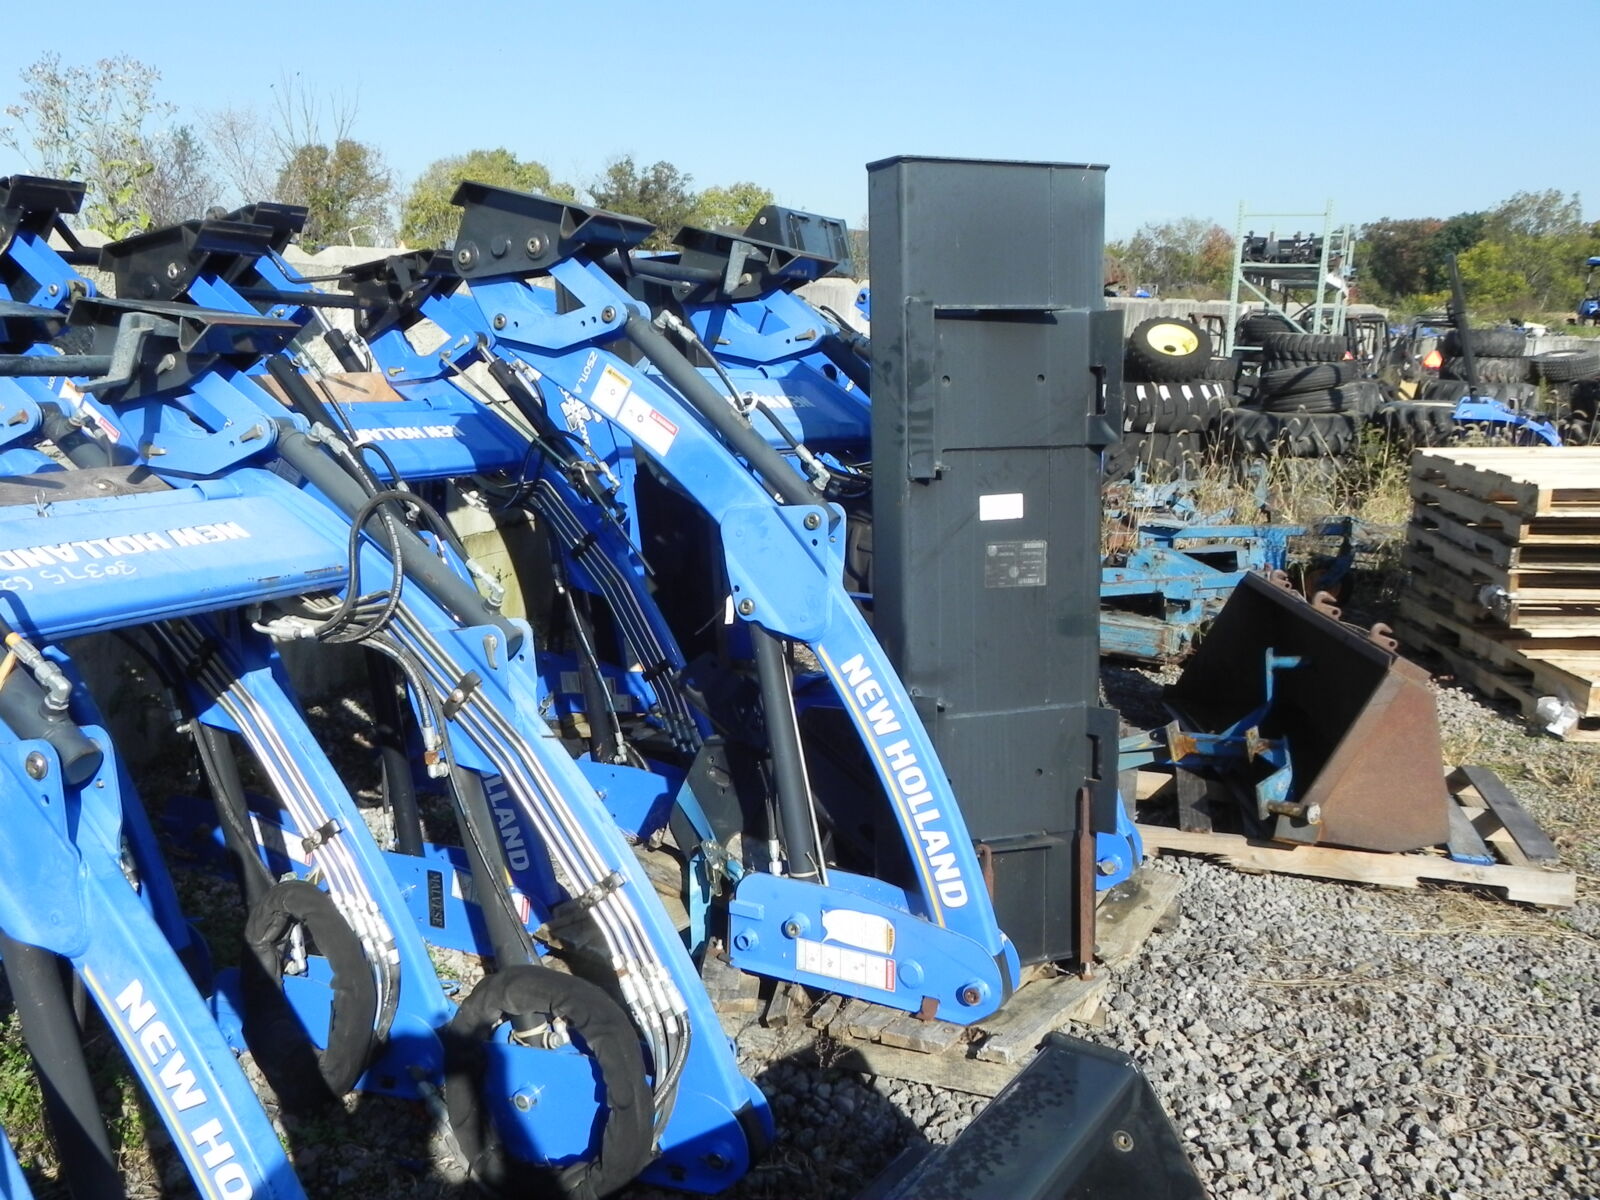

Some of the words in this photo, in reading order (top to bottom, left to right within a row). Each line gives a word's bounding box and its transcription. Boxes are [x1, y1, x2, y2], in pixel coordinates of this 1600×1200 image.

[344, 426, 427, 441] HOLLAN
[0, 532, 172, 571] HOLLAND
[165, 521, 250, 547] NEW
[840, 653, 901, 736] NEW
[884, 739, 968, 908] HOLLAND
[481, 773, 530, 871] LLAND
[430, 873, 443, 926] MALVESE
[115, 978, 208, 1112] NEW
[191, 1117, 253, 1200] HO
